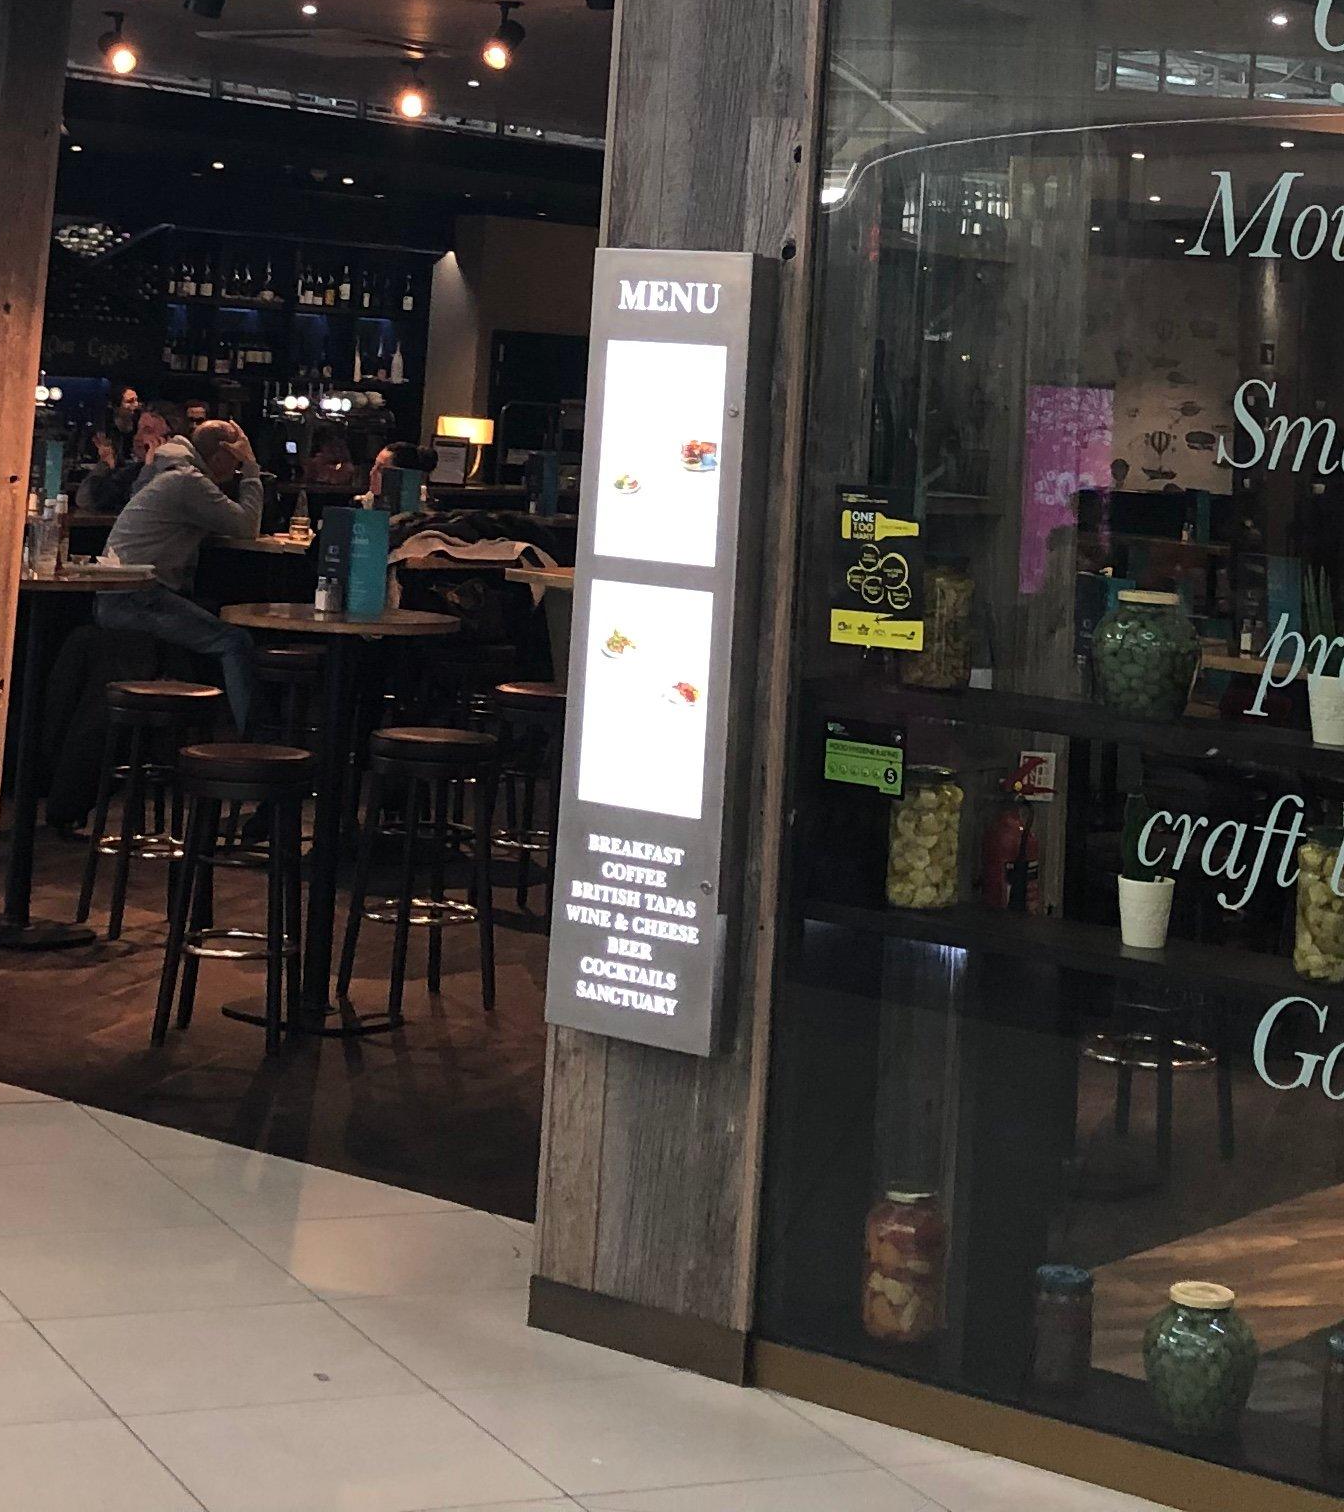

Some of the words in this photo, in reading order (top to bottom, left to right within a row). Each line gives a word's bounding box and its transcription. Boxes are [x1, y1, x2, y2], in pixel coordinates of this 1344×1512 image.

[617, 279, 723, 314] MENU
[852, 510, 874, 523] ONE
[852, 522, 874, 532] TOO
[886, 769, 895, 783] 5
[587, 834, 686, 866] BREAKFAST
[1136, 794, 1306, 909] craft
[601, 861, 667, 888] COFFEE
[570, 880, 641, 908] BRITISH
[644, 893, 697, 918] TAPAS
[566, 904, 612, 928] WINE
[614, 913, 629, 931] &
[632, 916, 700, 945] CHEESE
[606, 936, 653, 961] BEER
[580, 956, 677, 991] COCKTAILS
[575, 979, 679, 1016] SANCTUARY
